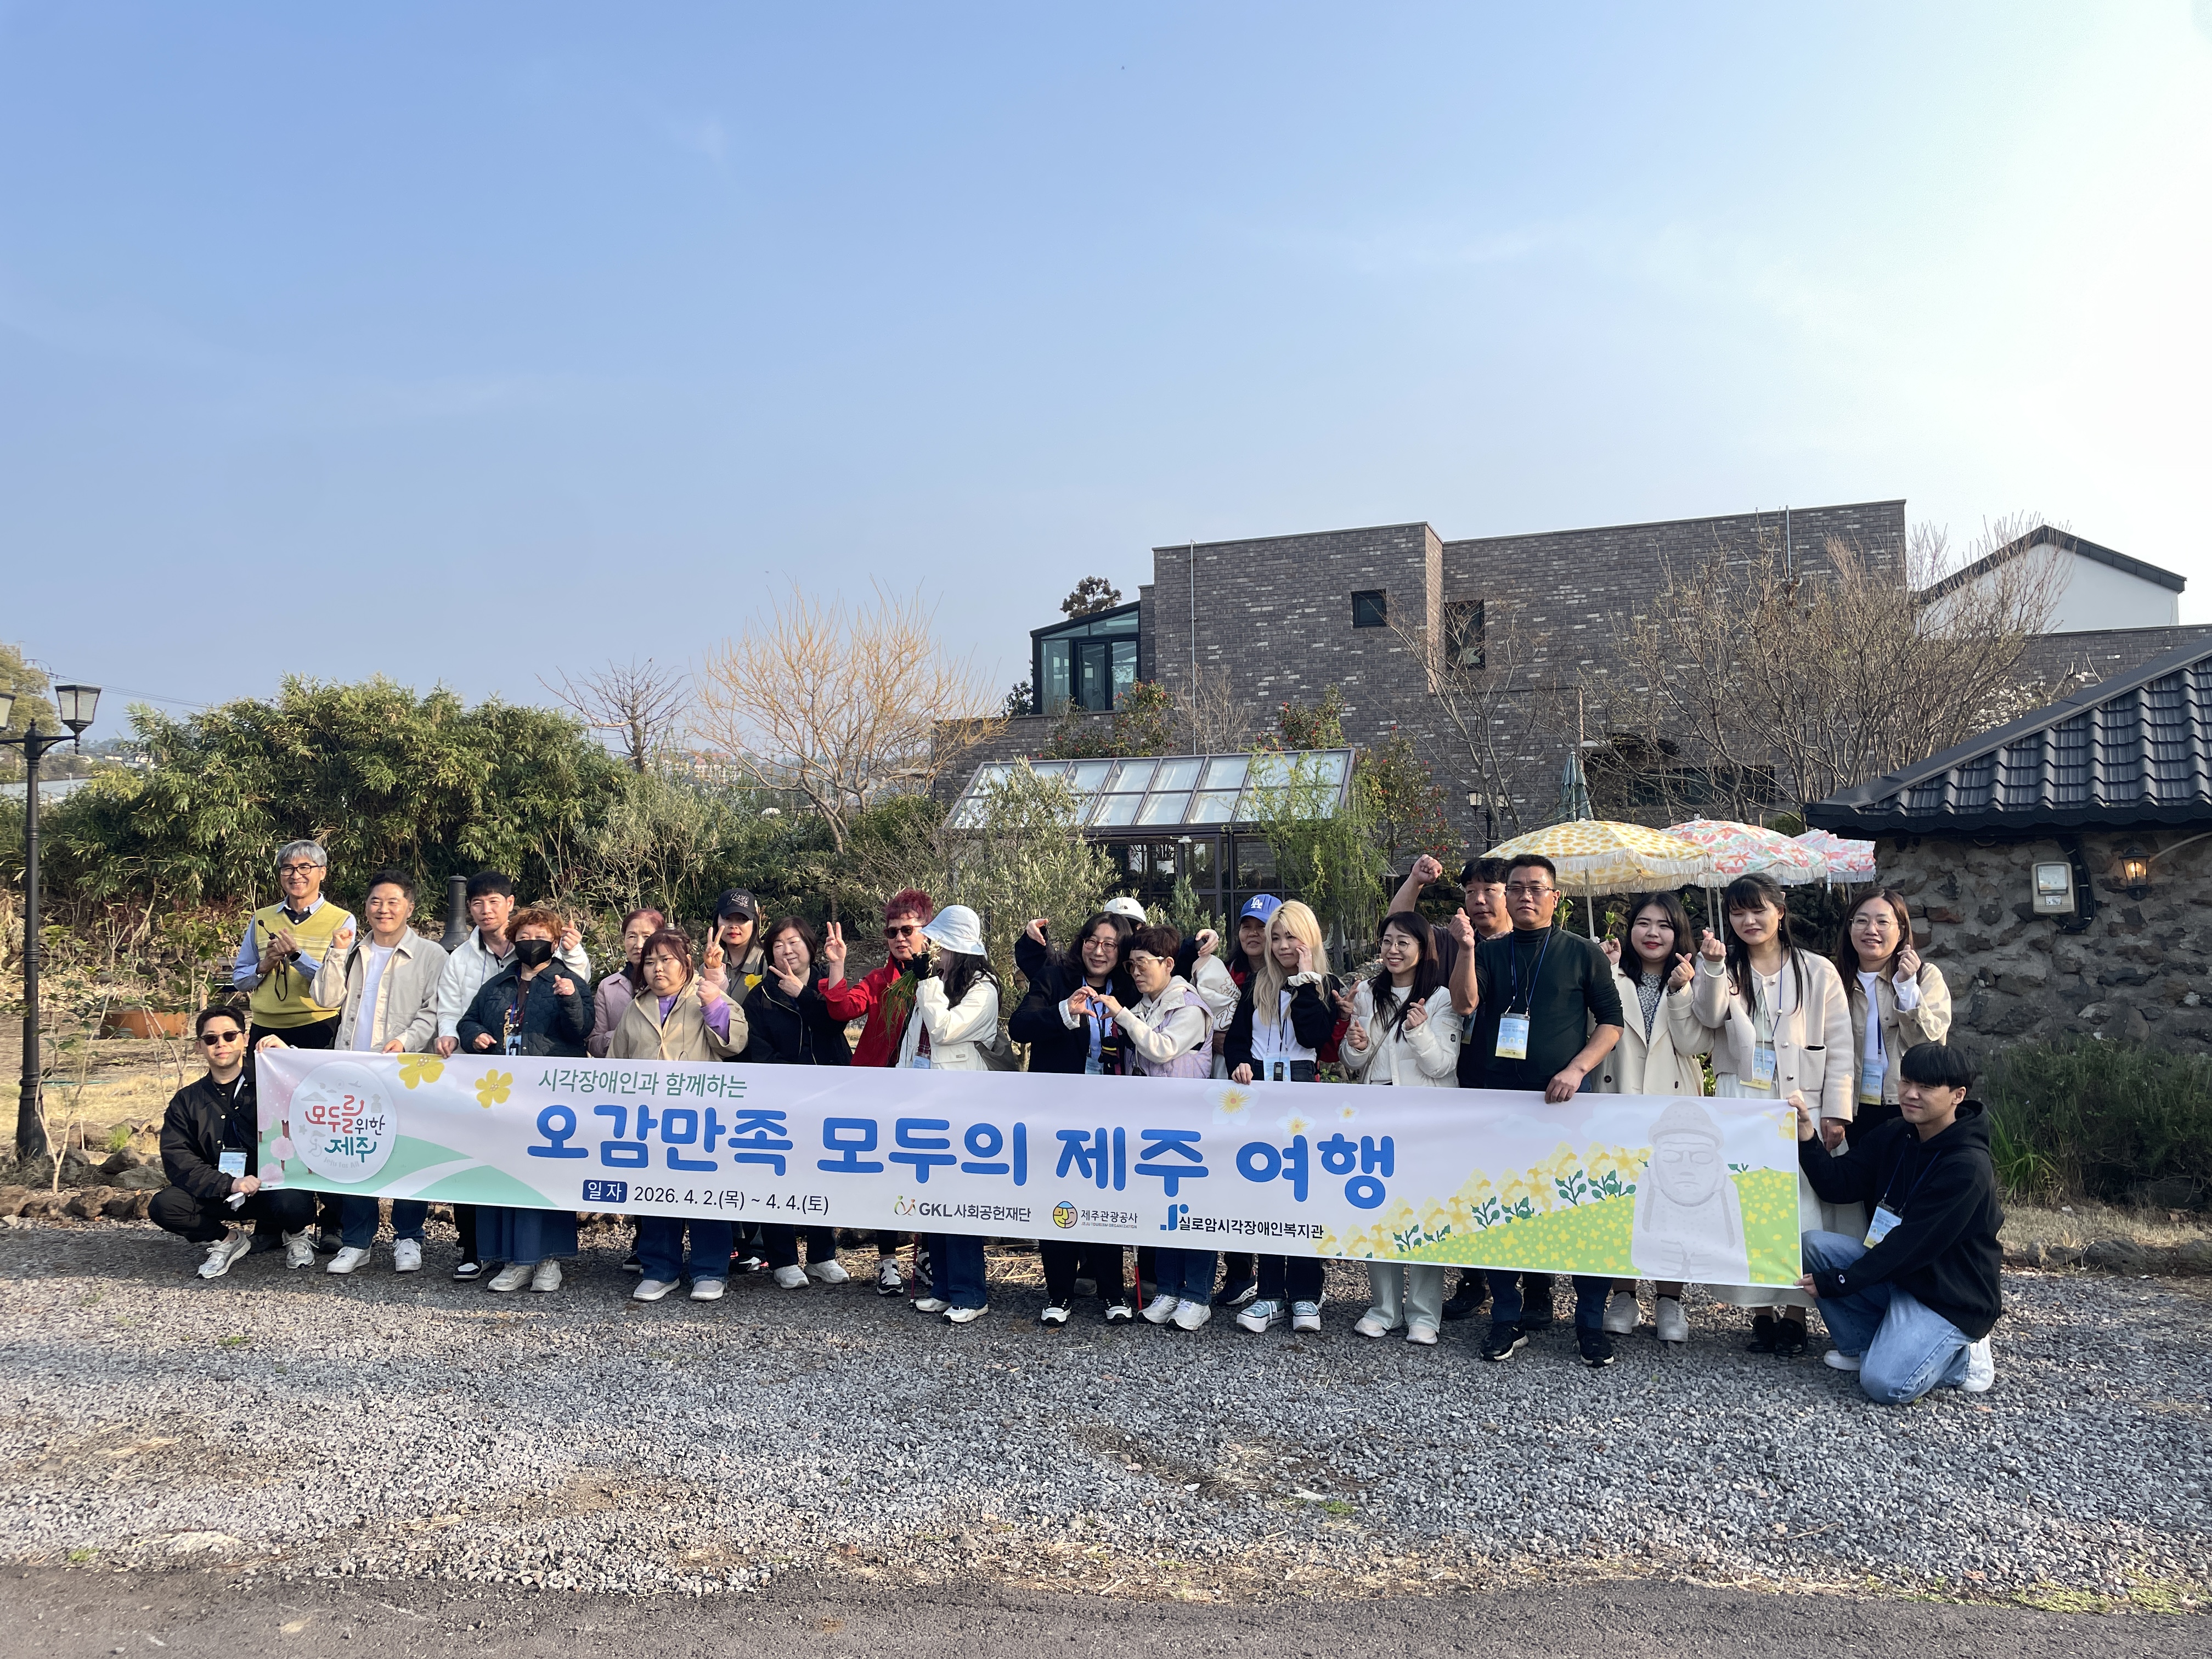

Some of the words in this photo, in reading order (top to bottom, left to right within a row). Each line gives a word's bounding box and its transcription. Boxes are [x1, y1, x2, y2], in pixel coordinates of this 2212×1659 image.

[1251, 897, 1263, 909] LA
[538, 1068, 659, 1096] 시각장애인과
[666, 1072, 748, 1098] 함께하는
[305, 1095, 364, 1133] 모두를
[355, 1115, 386, 1135] 위한
[324, 1136, 377, 1163] 제주
[324, 1157, 337, 1167] Jeju
[527, 1104, 793, 1176] 오감만족
[817, 1117, 1028, 1186] 모두의
[1056, 1126, 1209, 1198] 제주
[1235, 1133, 1395, 1209] 여행
[634, 1186, 679, 1204] 2026.
[684, 1189, 698, 1204] 4.
[703, 1190, 744, 1211] 2.(목)
[765, 1194, 780, 1209] 4.
[786, 1195, 829, 1216] 4.(토)
[1081, 1210, 1138, 1223] 제주관광공사
[1179, 1216, 1324, 1239] 실로암시각장애인복지관
